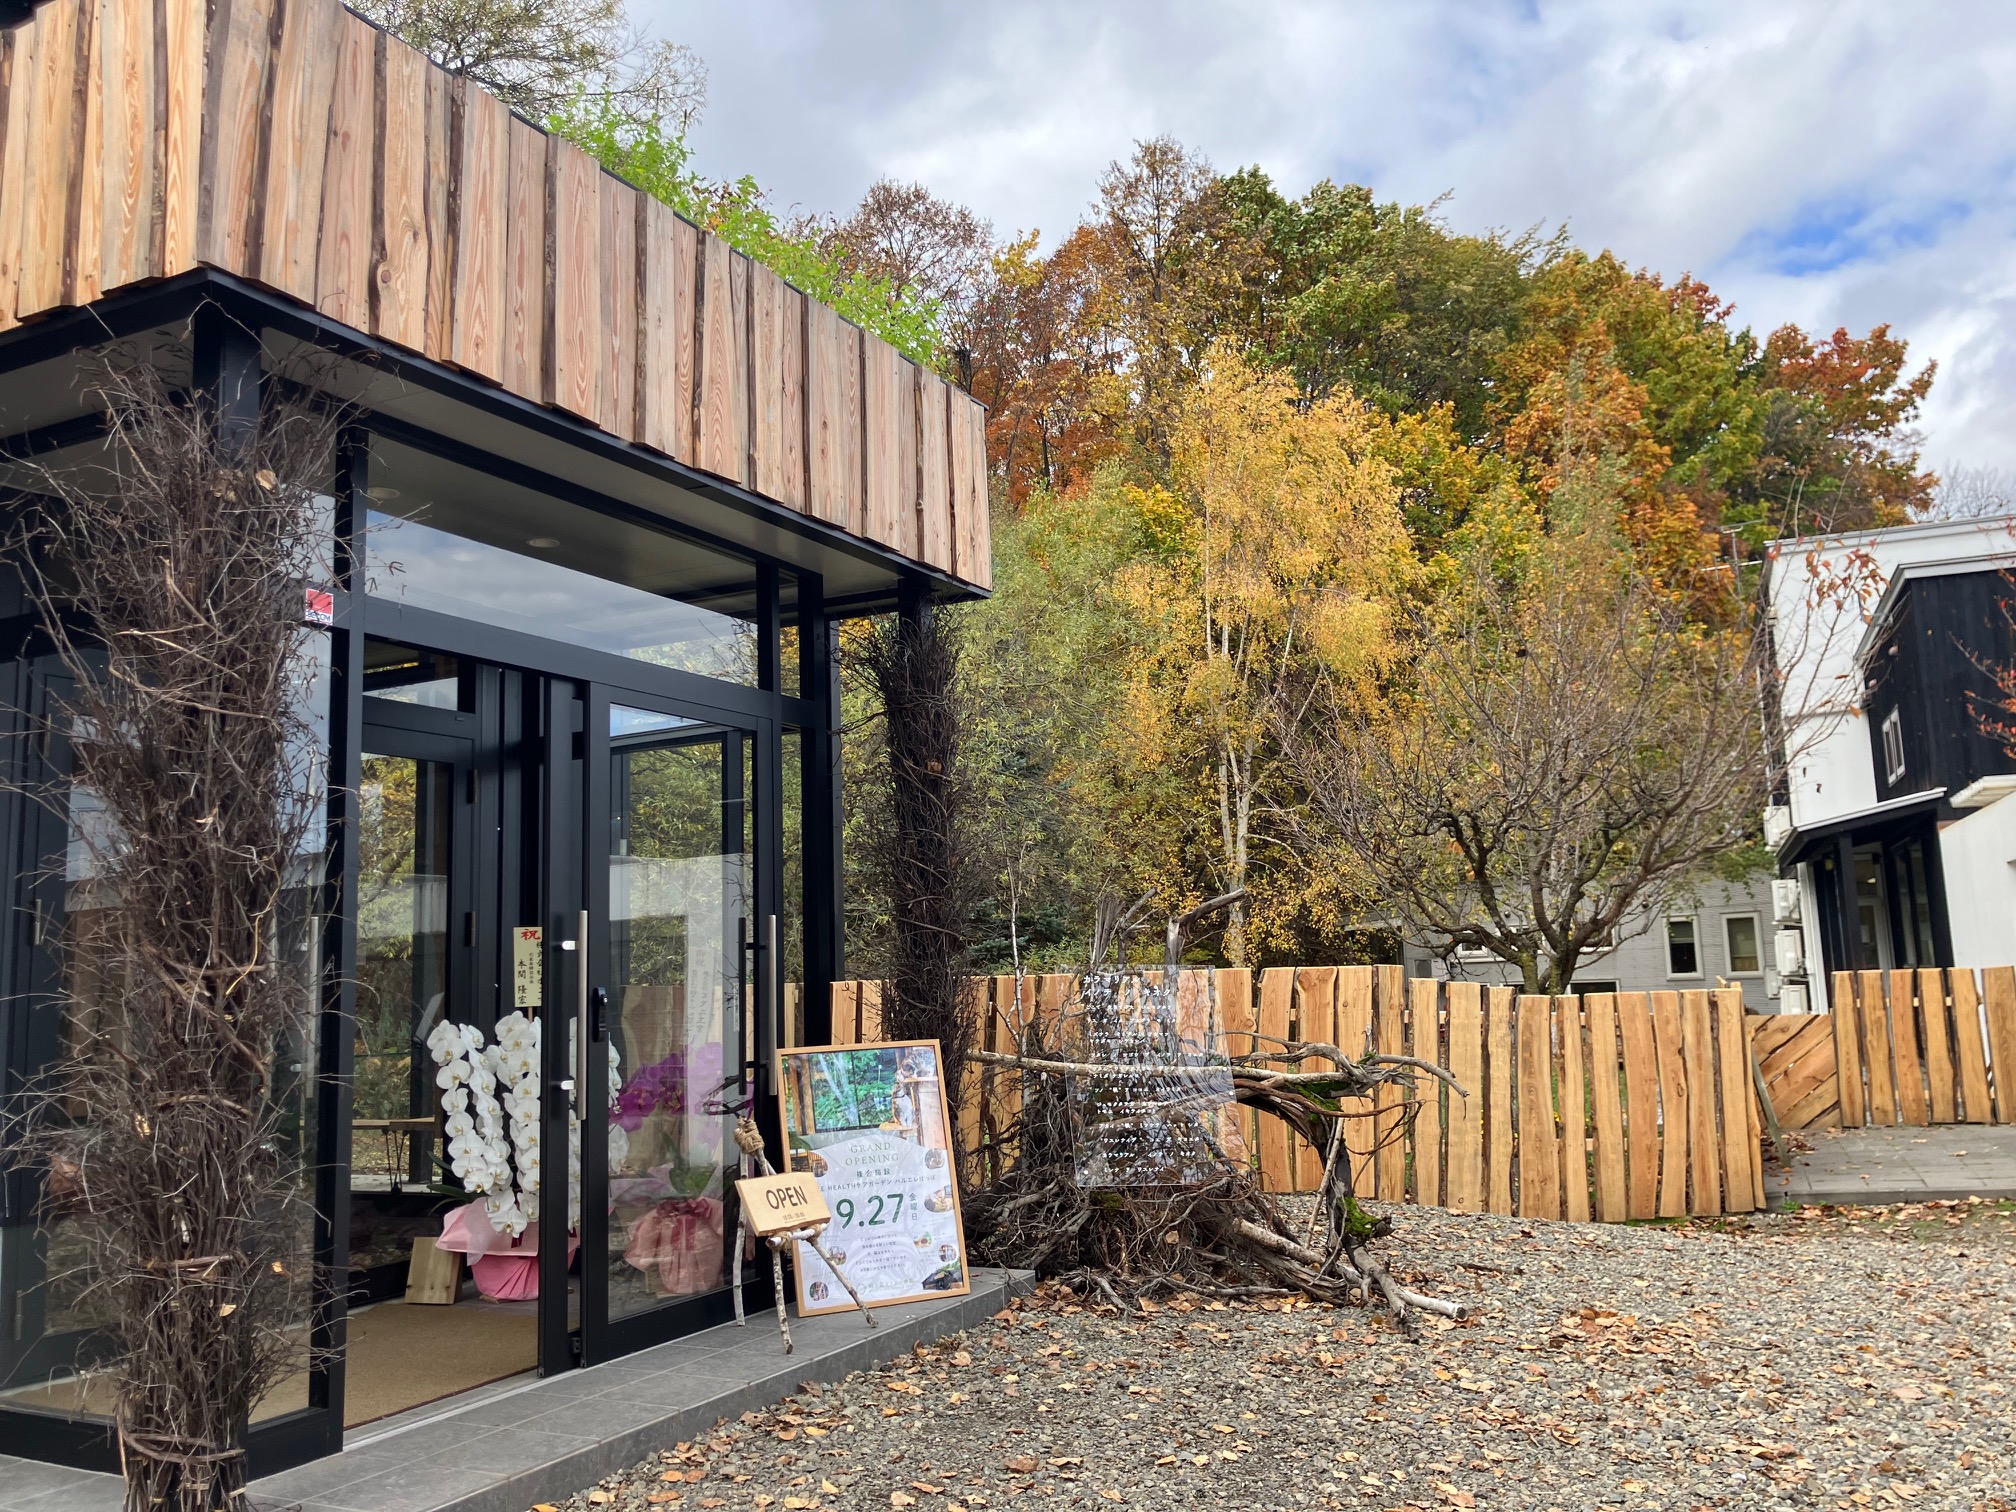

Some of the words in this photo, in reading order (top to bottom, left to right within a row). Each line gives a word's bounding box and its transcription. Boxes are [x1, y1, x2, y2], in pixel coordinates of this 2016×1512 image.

[521, 929, 541, 941] 祝
[1083, 975, 1141, 985] カラマリアル
[1143, 988, 1171, 997] キオク
[851, 1142, 891, 1153] GRAND
[845, 1154, 899, 1166] OPENING
[827, 1179, 892, 1191] HEALTHケアガーデン
[766, 1186, 808, 1209] OPEN
[836, 1193, 904, 1230] 9.27
[909, 1192, 918, 1221] 金曜日
